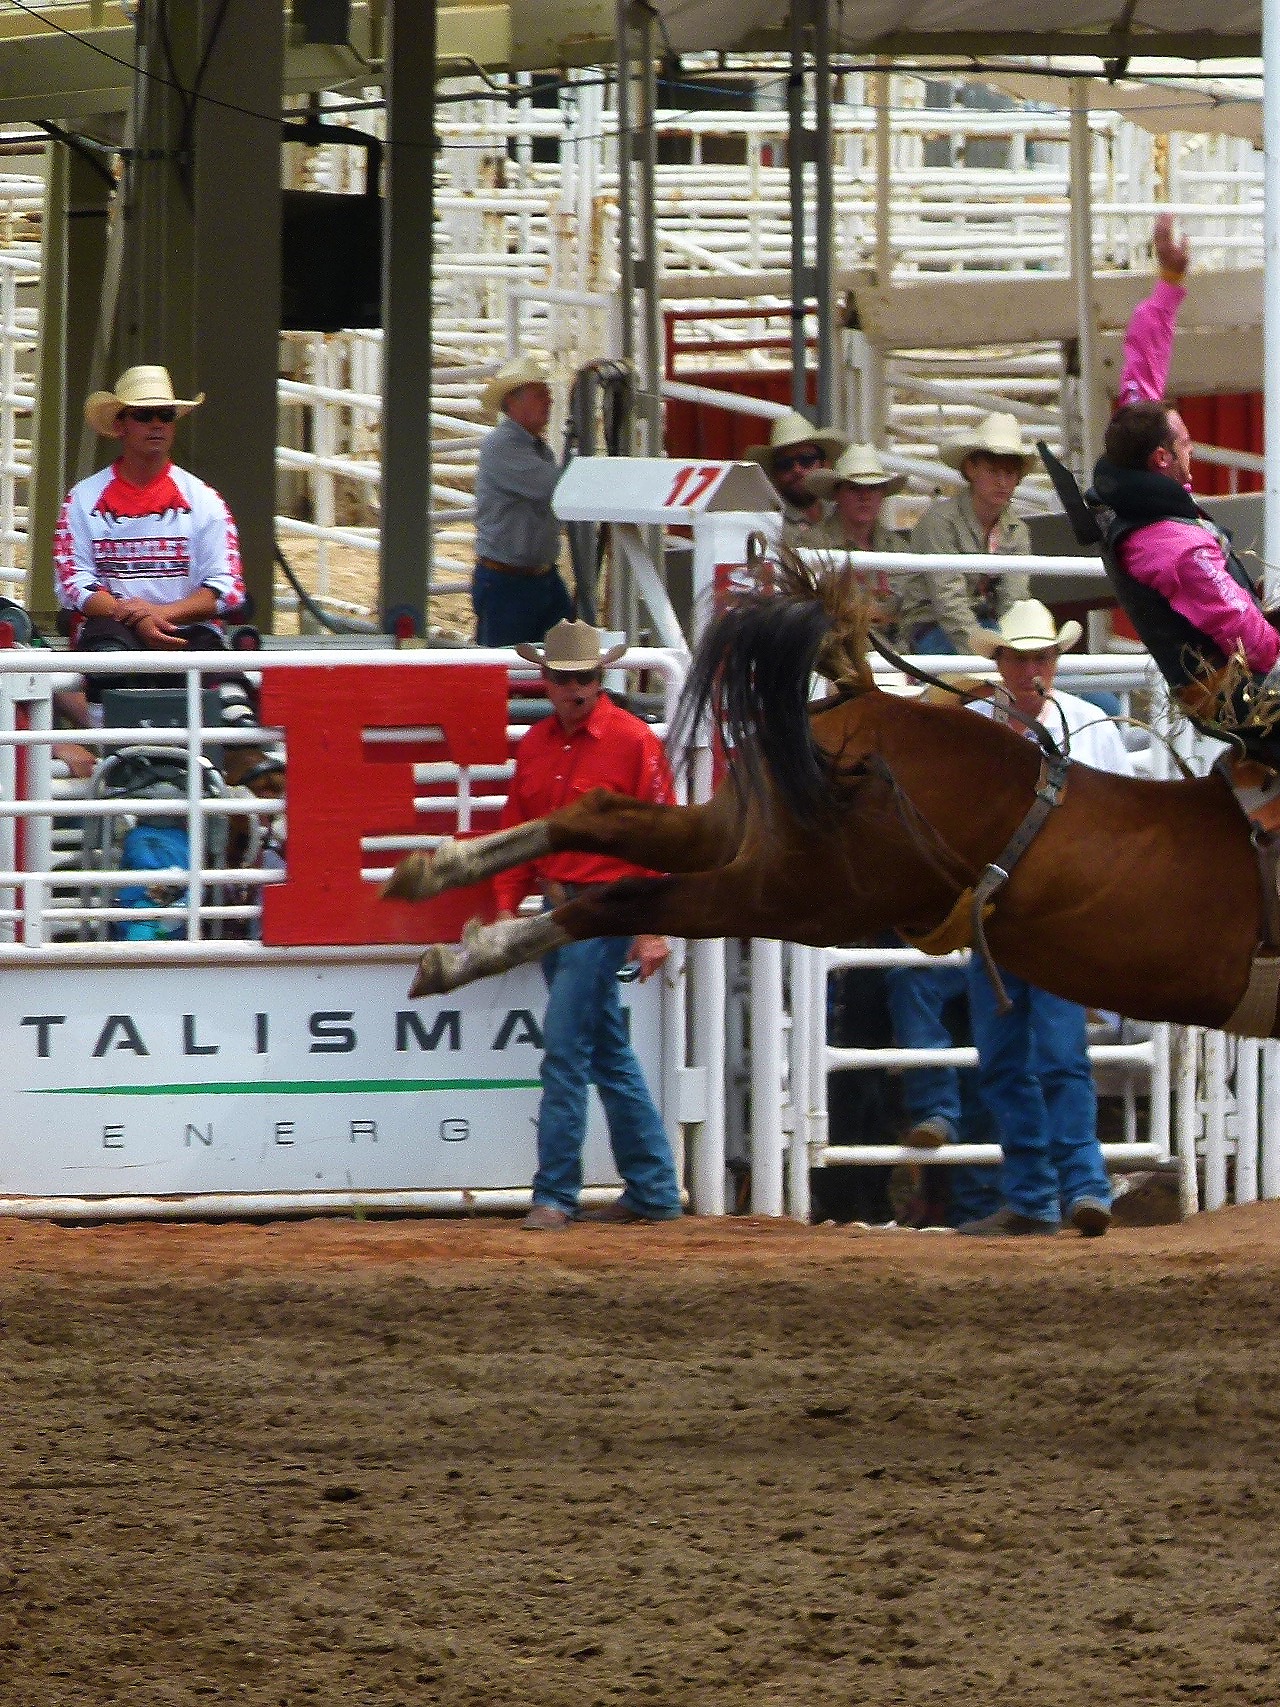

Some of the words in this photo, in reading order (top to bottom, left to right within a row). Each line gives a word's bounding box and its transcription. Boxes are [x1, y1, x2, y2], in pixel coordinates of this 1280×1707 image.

[664, 466, 721, 507] 17
[20, 1008, 631, 1058] TALISMA
[102, 1116, 540, 1149] ENERG
